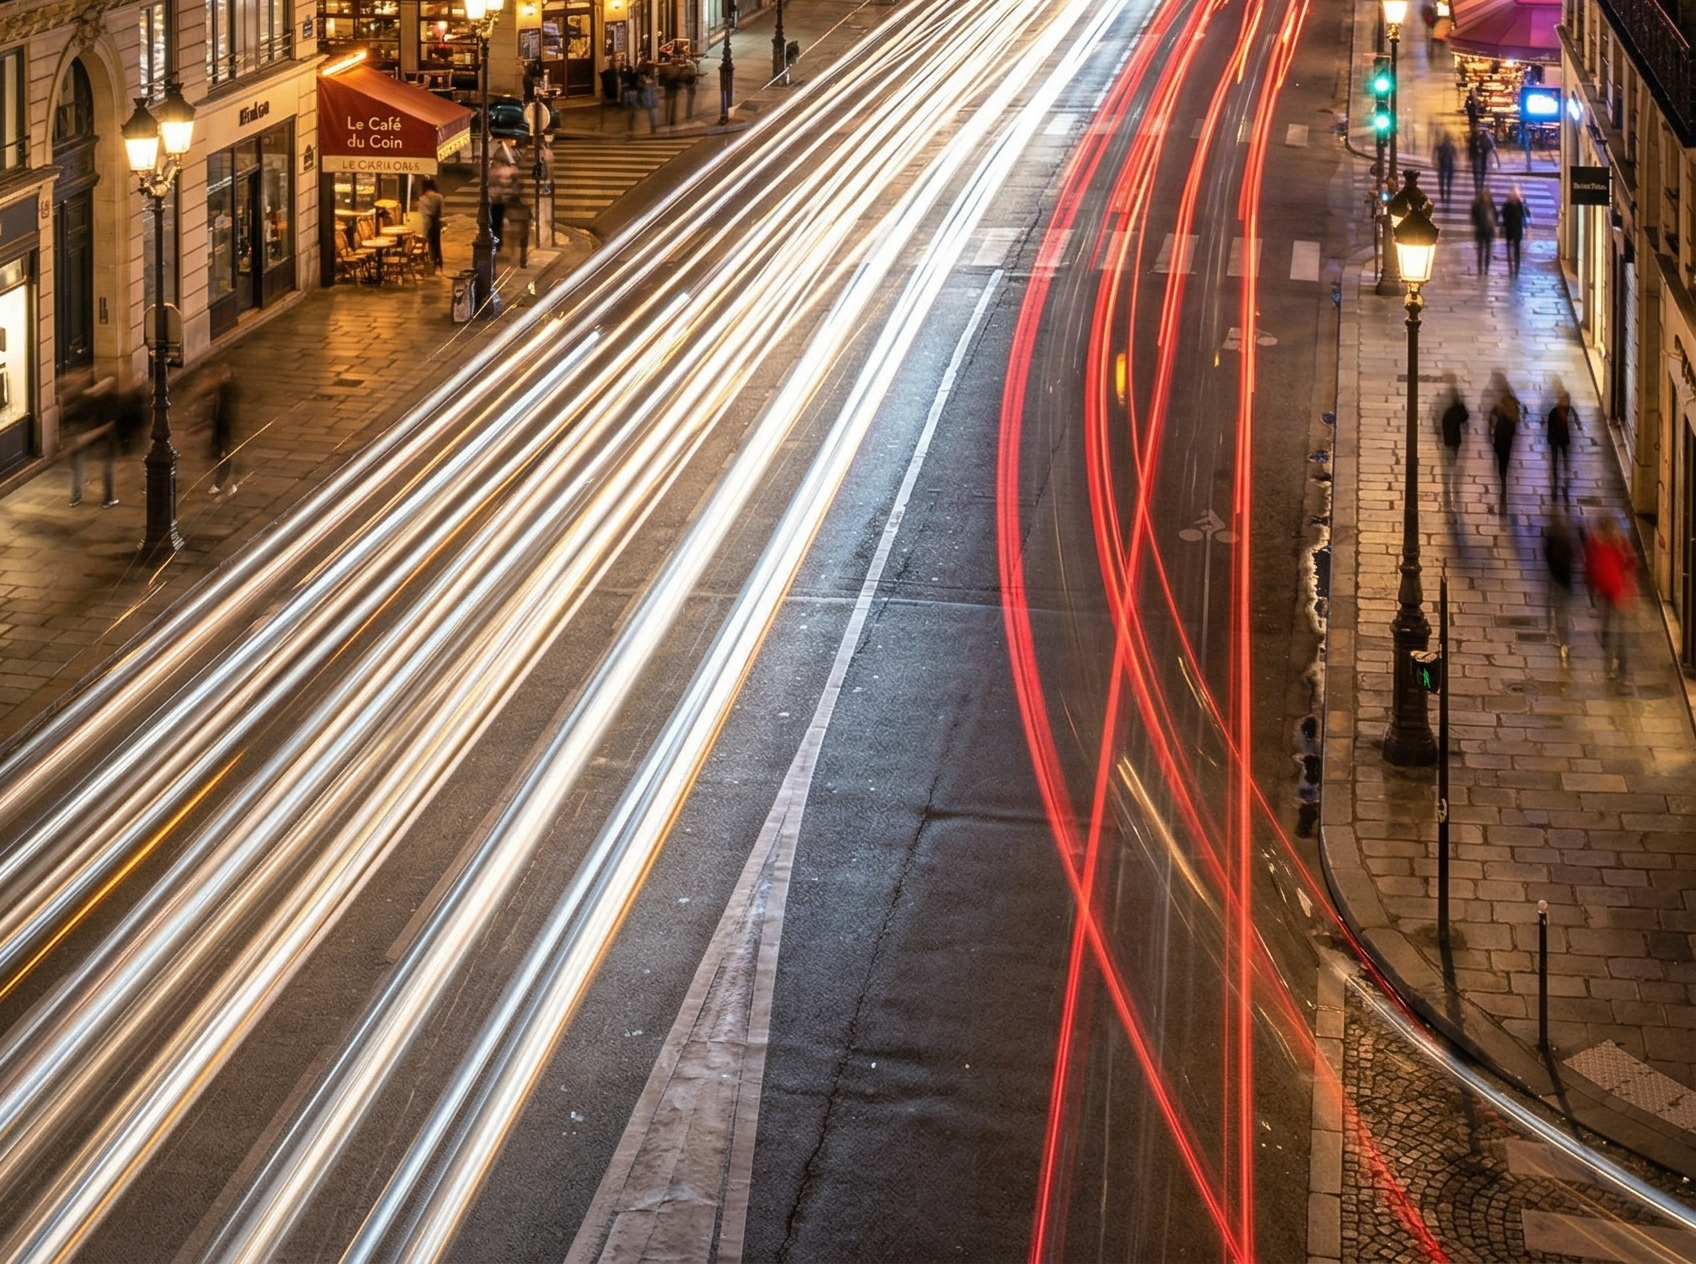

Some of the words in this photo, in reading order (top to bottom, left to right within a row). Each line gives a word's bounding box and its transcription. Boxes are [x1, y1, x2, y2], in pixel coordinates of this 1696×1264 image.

[347, 116, 364, 130] Le
[368, 116, 402, 131] Café
[347, 133, 365, 148] du
[369, 134, 403, 149] Coin
